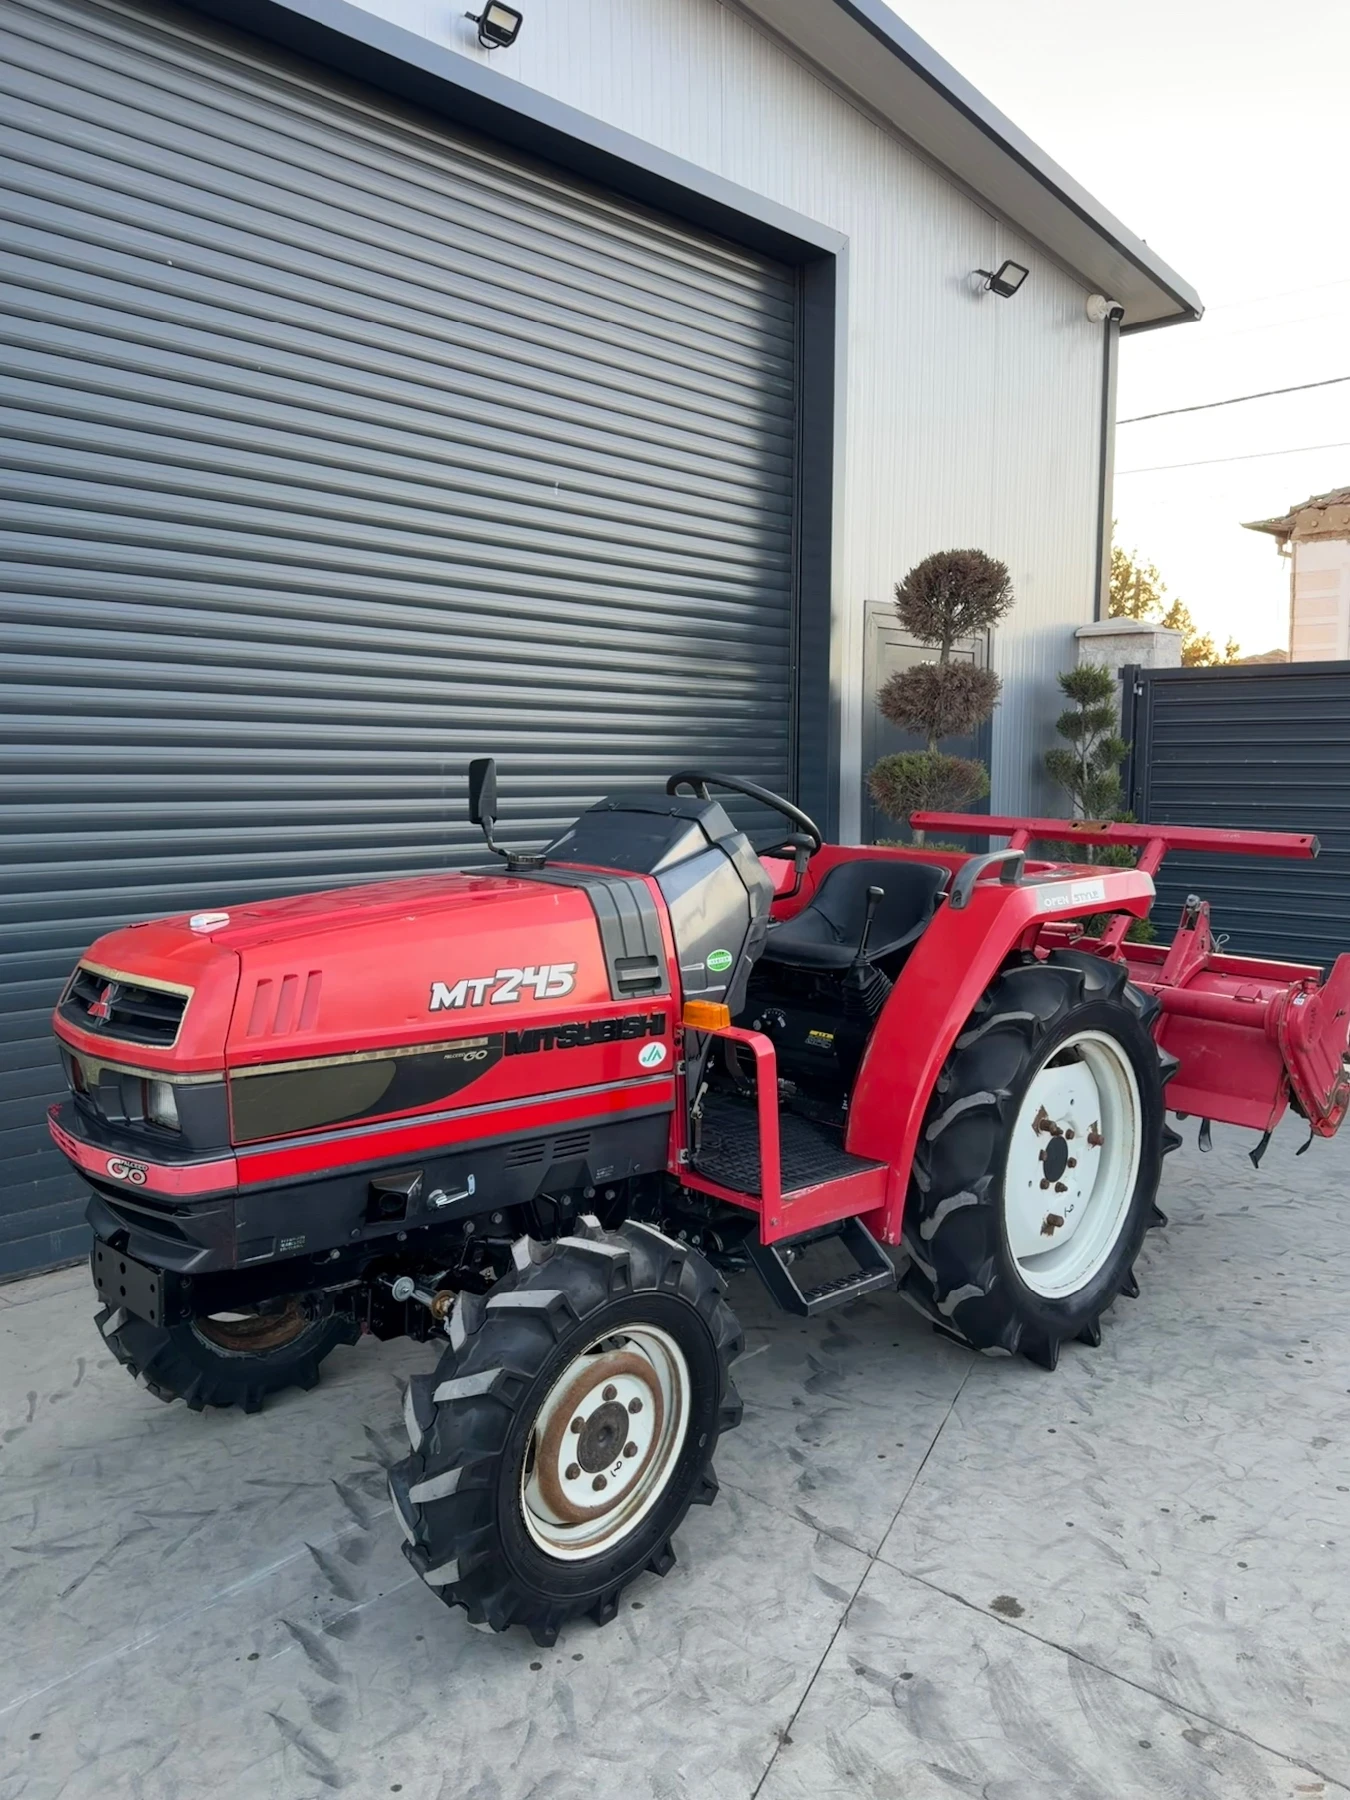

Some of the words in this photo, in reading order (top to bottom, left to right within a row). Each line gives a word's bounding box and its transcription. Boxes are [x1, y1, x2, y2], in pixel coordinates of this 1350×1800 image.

[1044, 895, 1070, 907] OPEN
[429, 962, 578, 1011] MT245
[505, 1013, 666, 1055] MITSUBISHI
